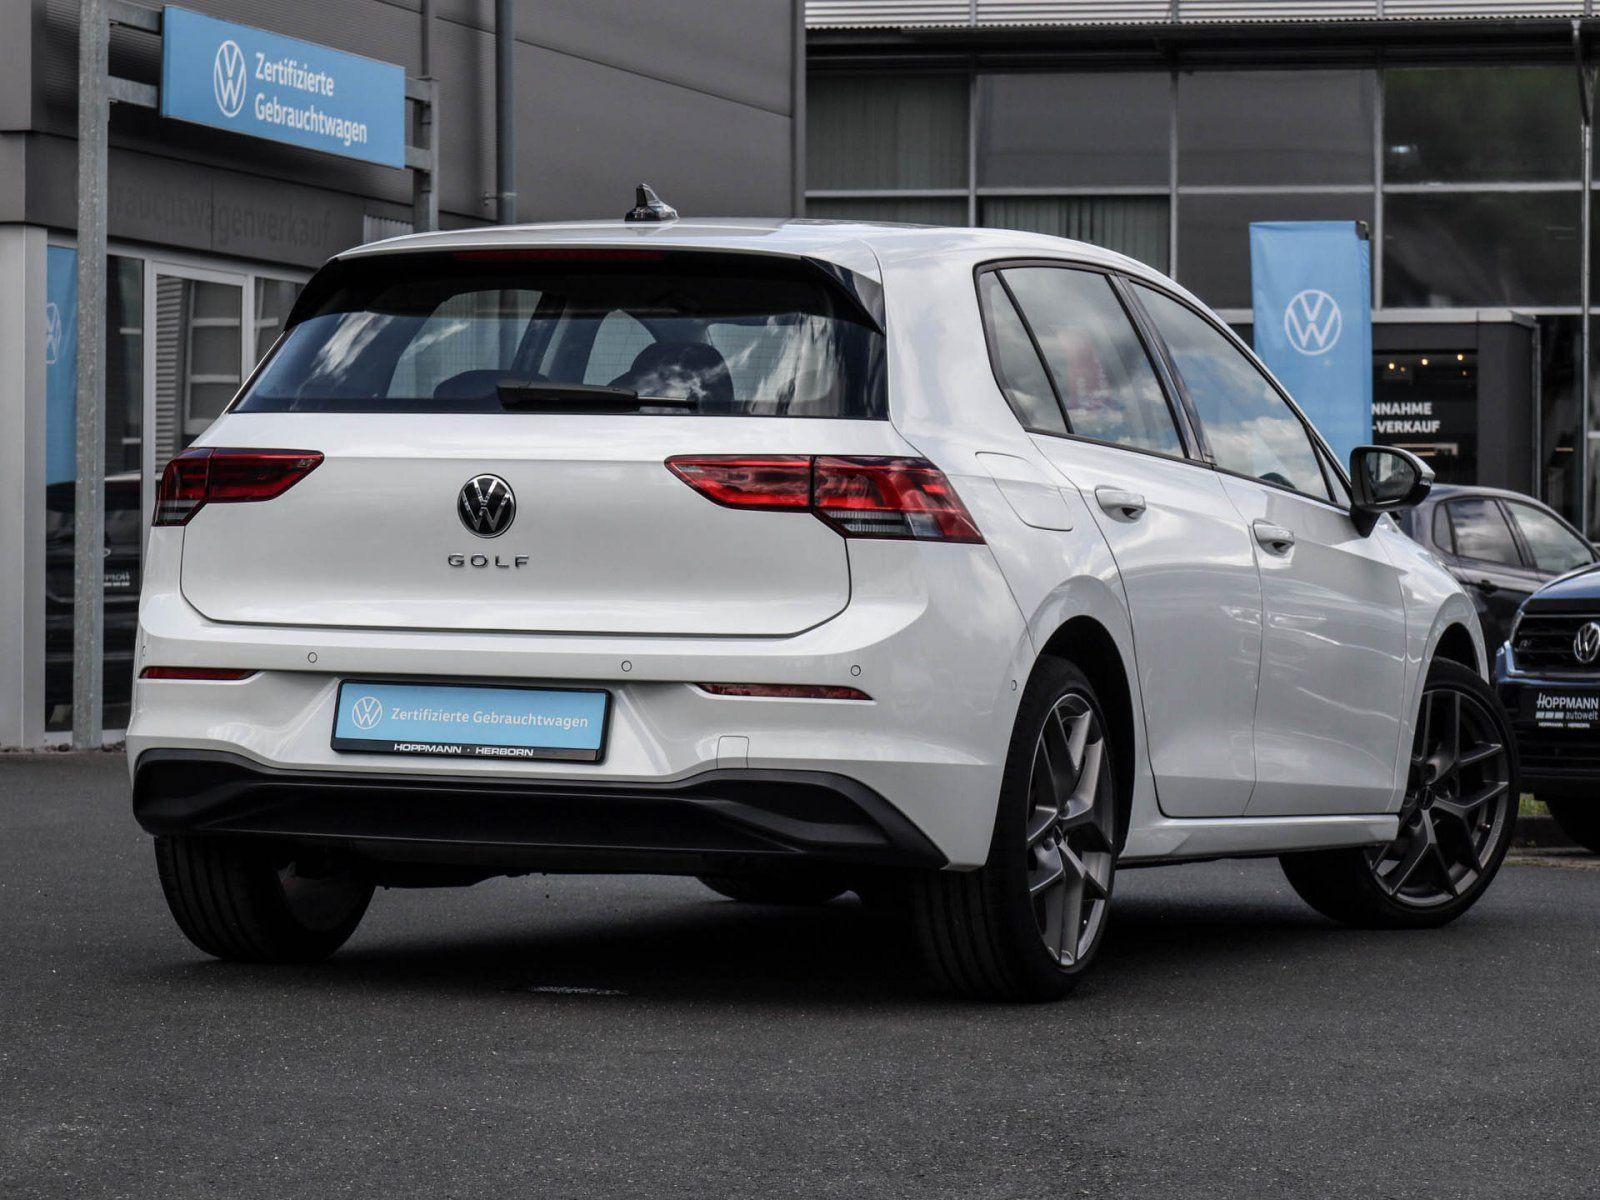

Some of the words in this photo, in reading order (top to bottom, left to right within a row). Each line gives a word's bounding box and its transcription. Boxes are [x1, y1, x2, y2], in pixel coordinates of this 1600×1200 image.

[255, 53, 334, 97] Zertifizierte
[255, 94, 367, 146] Gebrauchtwagen
[1371, 402, 1432, 415] NNAHME
[1372, 420, 1440, 433] -VERKAUF
[447, 554, 529, 569] GOLF
[1536, 692, 1599, 709] HOPPMANN
[391, 707, 469, 724] Zertifizierte
[472, 711, 589, 730] Gebrauchtwagen
[1565, 711, 1599, 720] autowelt
[394, 743, 461, 754] HOPPMANN
[475, 747, 534, 757] HERBORN
